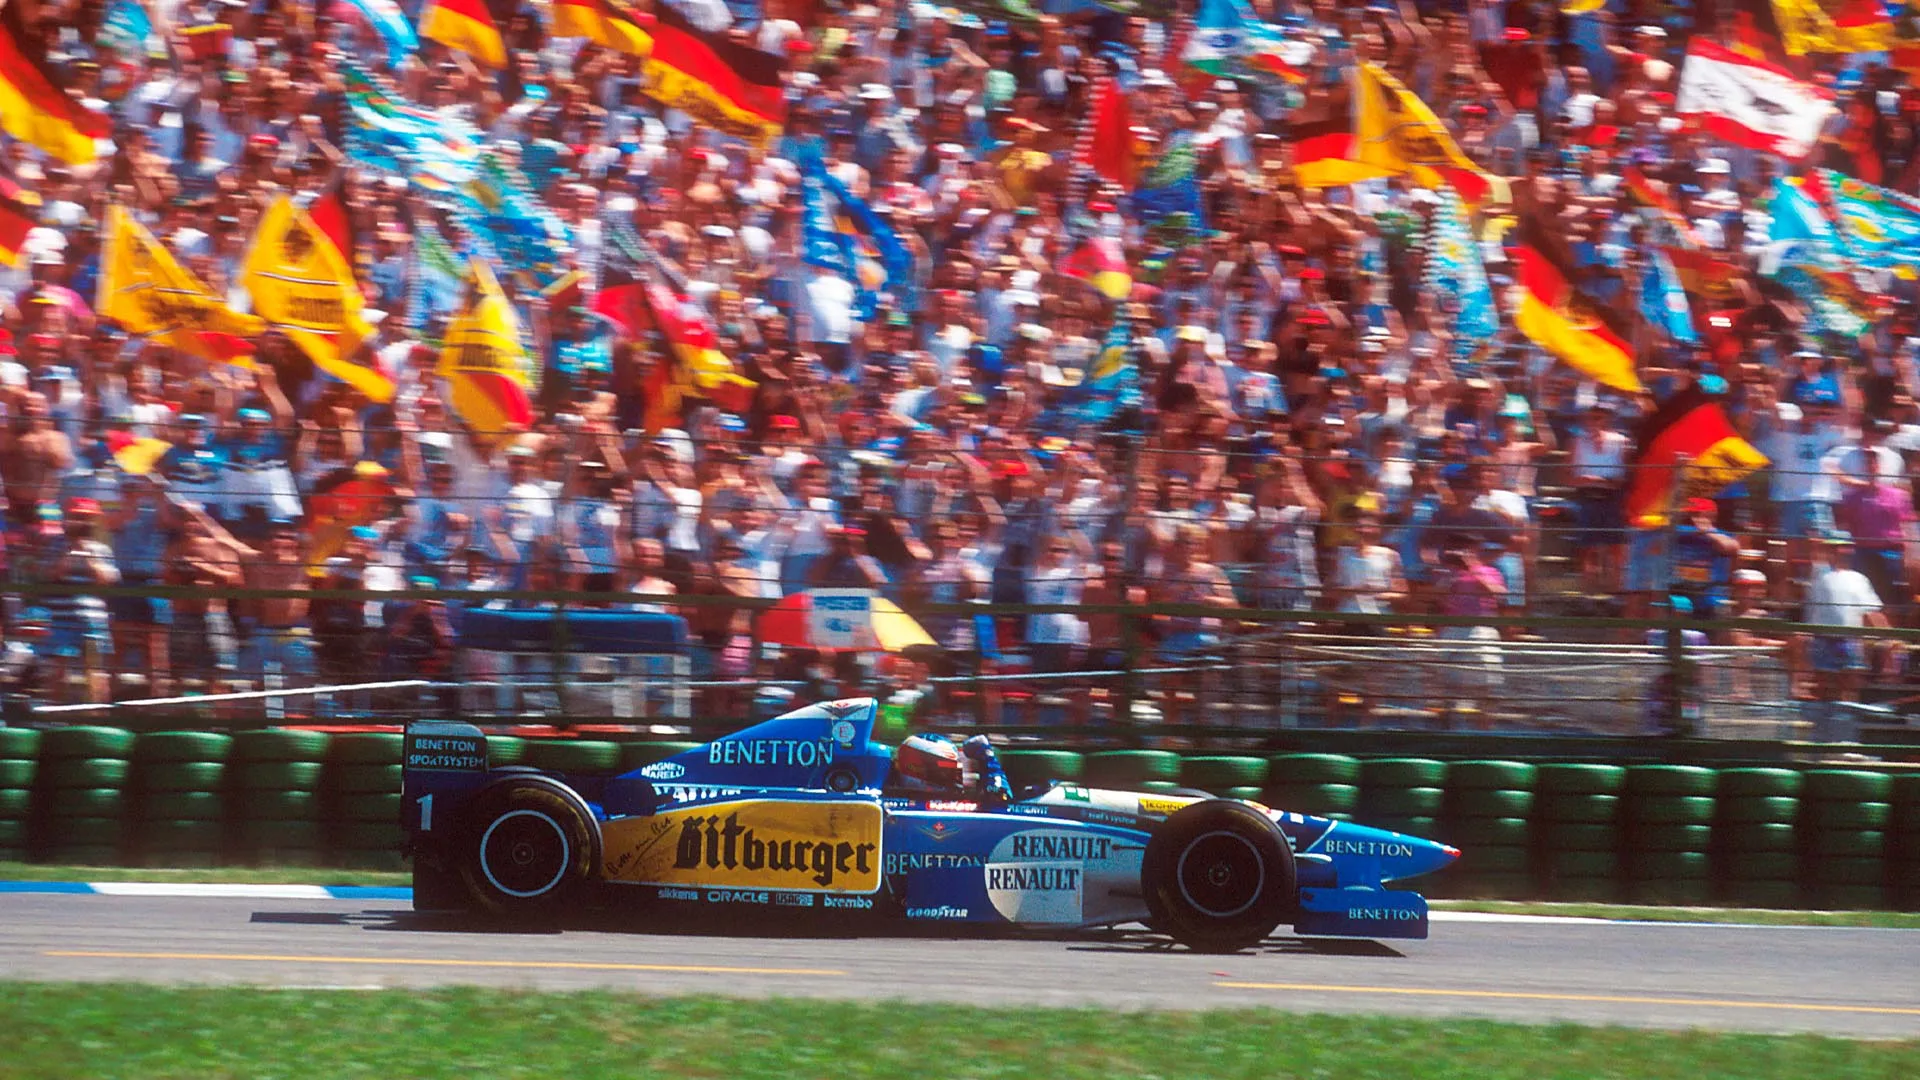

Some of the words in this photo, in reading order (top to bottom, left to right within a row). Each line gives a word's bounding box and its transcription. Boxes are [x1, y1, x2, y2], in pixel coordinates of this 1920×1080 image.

[416, 738, 477, 752] BENETTON
[709, 740, 833, 766] BENETTON
[409, 754, 484, 767] SPORTSYSTEM
[416, 793, 433, 831] 1
[673, 812, 875, 886] Bitburger
[1013, 836, 1111, 859] RENAULT
[1325, 839, 1412, 857] BENETTON
[989, 868, 1079, 890] RENAULT
[707, 890, 769, 904] ORACLE
[824, 895, 873, 909] brembo
[907, 905, 968, 918] GOODYEAR
[1349, 908, 1420, 921] BENETTON
